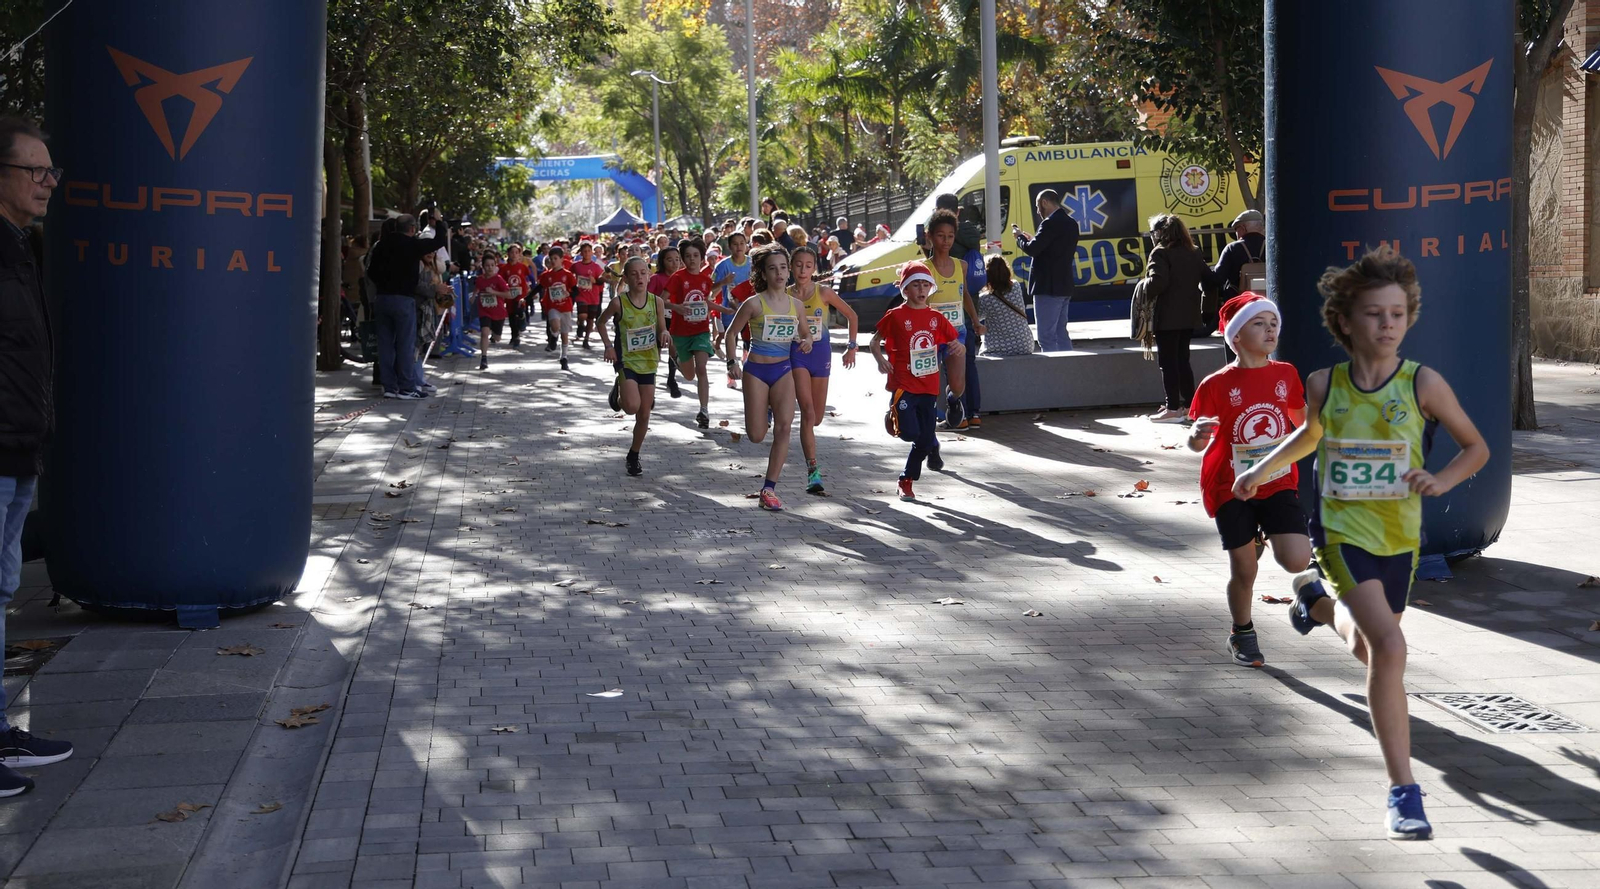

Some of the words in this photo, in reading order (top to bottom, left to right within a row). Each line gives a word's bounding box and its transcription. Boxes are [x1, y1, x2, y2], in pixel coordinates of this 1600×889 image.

[1005, 156, 1015, 165] 39
[1025, 146, 1148, 162] AMBULANCIA
[495, 160, 575, 169] AYUTAMIENTO
[533, 169, 570, 177] ECIRAS
[65, 181, 293, 218] CUPRA
[1328, 177, 1512, 211] CUPRA
[73, 239, 281, 272] TURIAL
[945, 310, 959, 320] 09
[768, 325, 795, 336] 728
[631, 333, 656, 346] 672
[915, 356, 937, 369] 699
[1232, 412, 1247, 436] CARRERA
[1274, 407, 1282, 415] DE
[1330, 461, 1396, 484] 634
